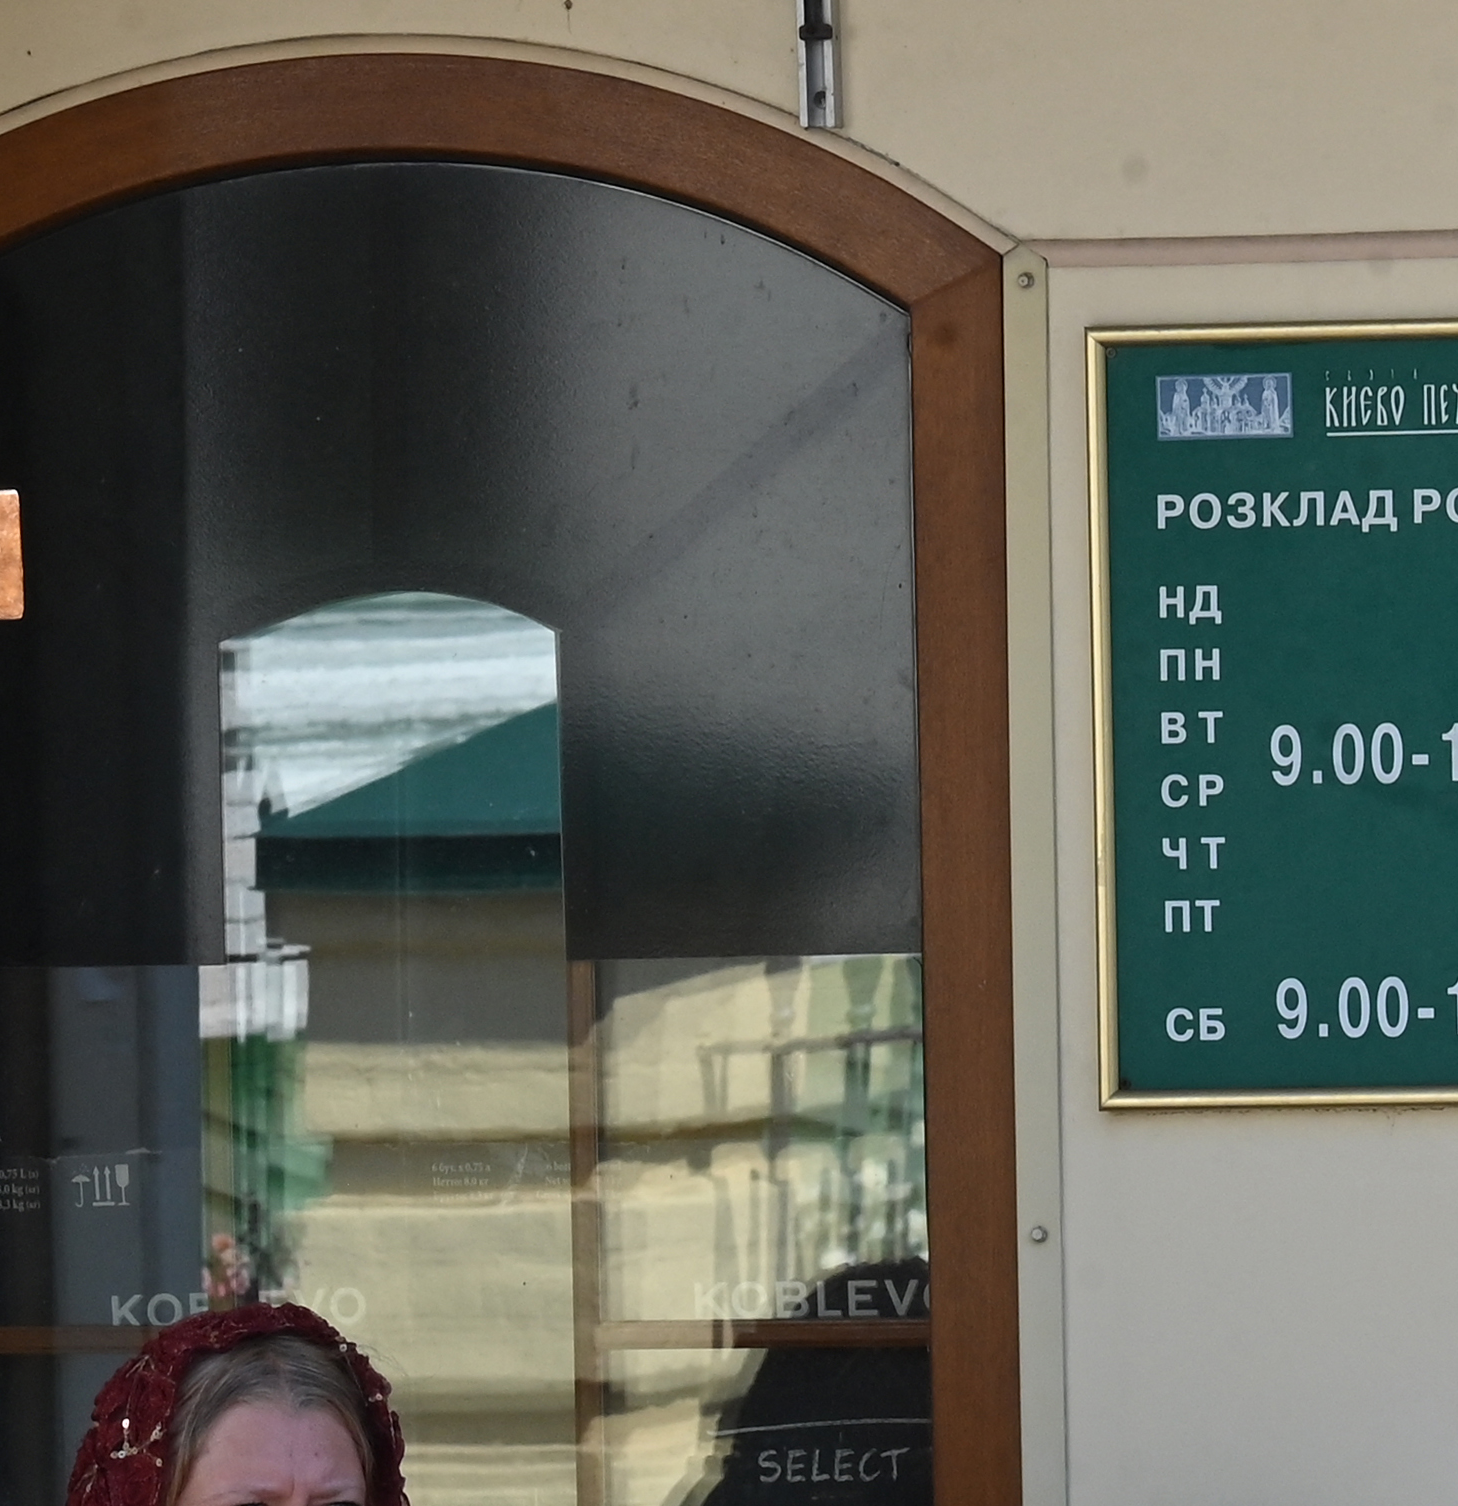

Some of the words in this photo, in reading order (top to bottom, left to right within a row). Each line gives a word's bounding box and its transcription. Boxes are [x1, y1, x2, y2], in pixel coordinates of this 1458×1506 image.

[1156, 489, 1398, 533] РОЗКЛАД
[1157, 585, 1223, 626] НД
[1158, 647, 1223, 682] ПН
[1159, 711, 1224, 745] ВТ
[1159, 773, 1225, 808] СР
[1161, 836, 1227, 871] ЧТ
[1163, 898, 1221, 933] ПТ
[1165, 1007, 1227, 1043] СБ
[693, 1278, 932, 1320] KOBLEV
[756, 1446, 912, 1485] SELECT
